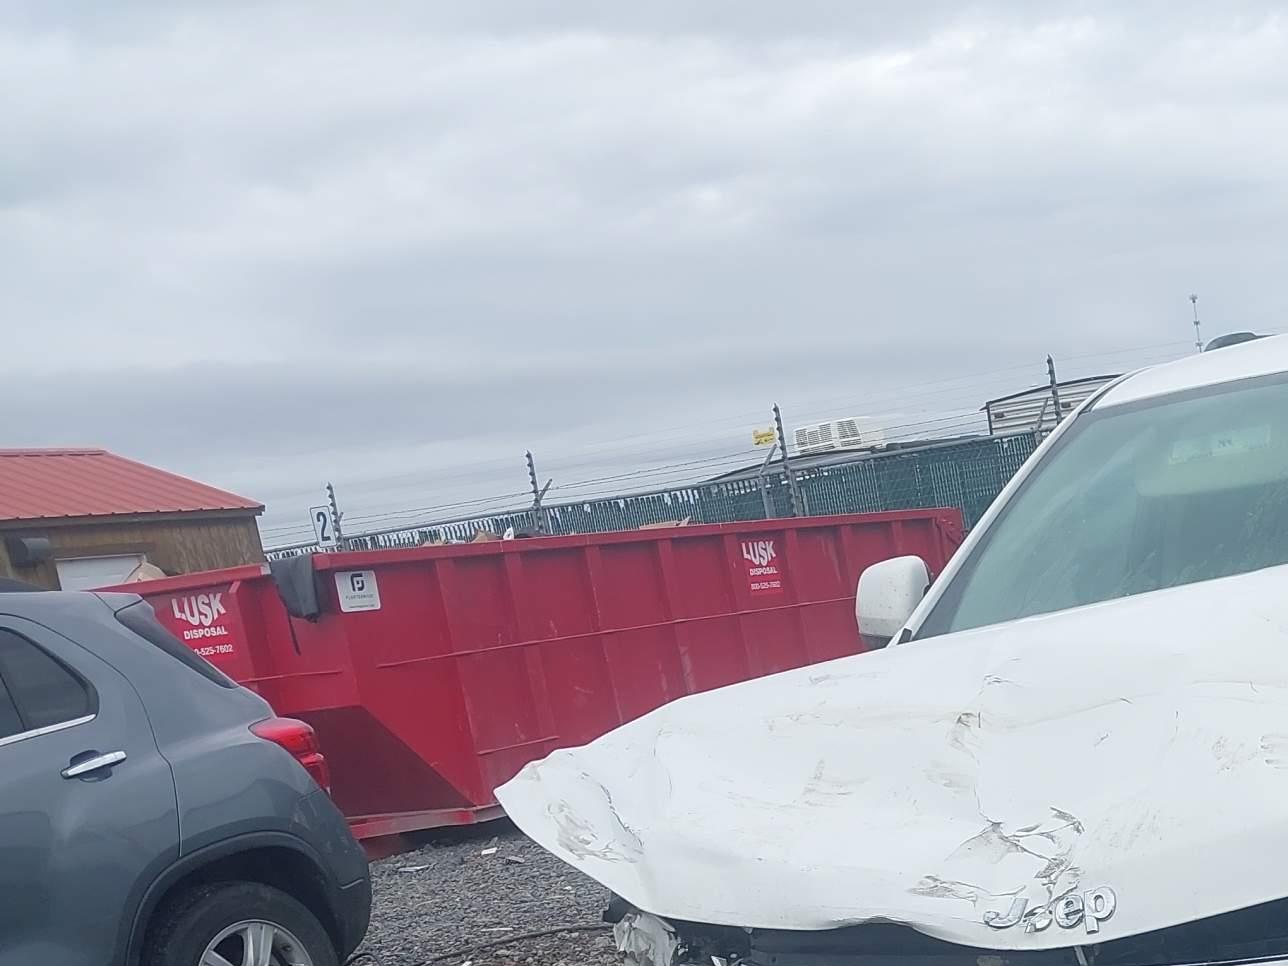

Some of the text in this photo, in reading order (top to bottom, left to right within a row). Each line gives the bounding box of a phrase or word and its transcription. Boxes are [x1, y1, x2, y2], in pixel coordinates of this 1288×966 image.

[316, 511, 331, 541] 2
[741, 540, 776, 566] LUSK
[171, 592, 226, 627] LUSK
[183, 626, 229, 641] DISPOSAL
[982, 886, 1117, 935] Jeep
